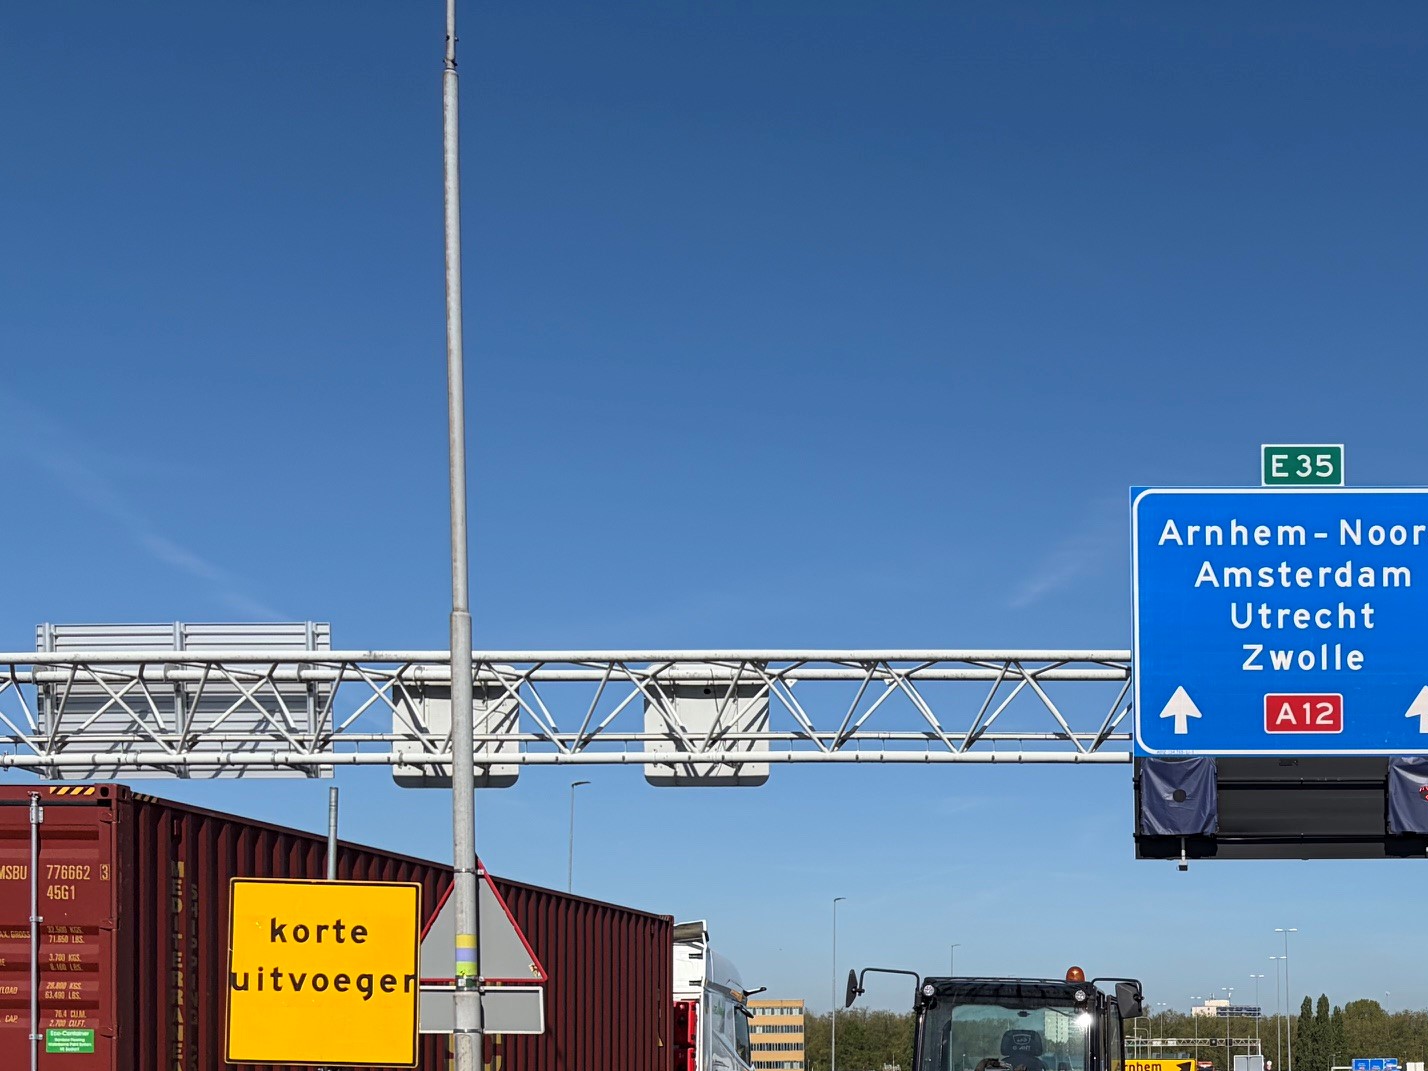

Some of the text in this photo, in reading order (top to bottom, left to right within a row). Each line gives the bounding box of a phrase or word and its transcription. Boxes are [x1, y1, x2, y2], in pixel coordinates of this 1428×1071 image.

[1193, 560, 1412, 588] Amsterdam
[1230, 601, 1375, 630] Utrecht
[1242, 642, 1365, 671] Zwolle
[1275, 701, 1335, 726] A12
[46, 864, 91, 880] 776662
[101, 864, 109, 880] 3
[46, 885, 76, 900] 45G1
[270, 916, 369, 945] korte
